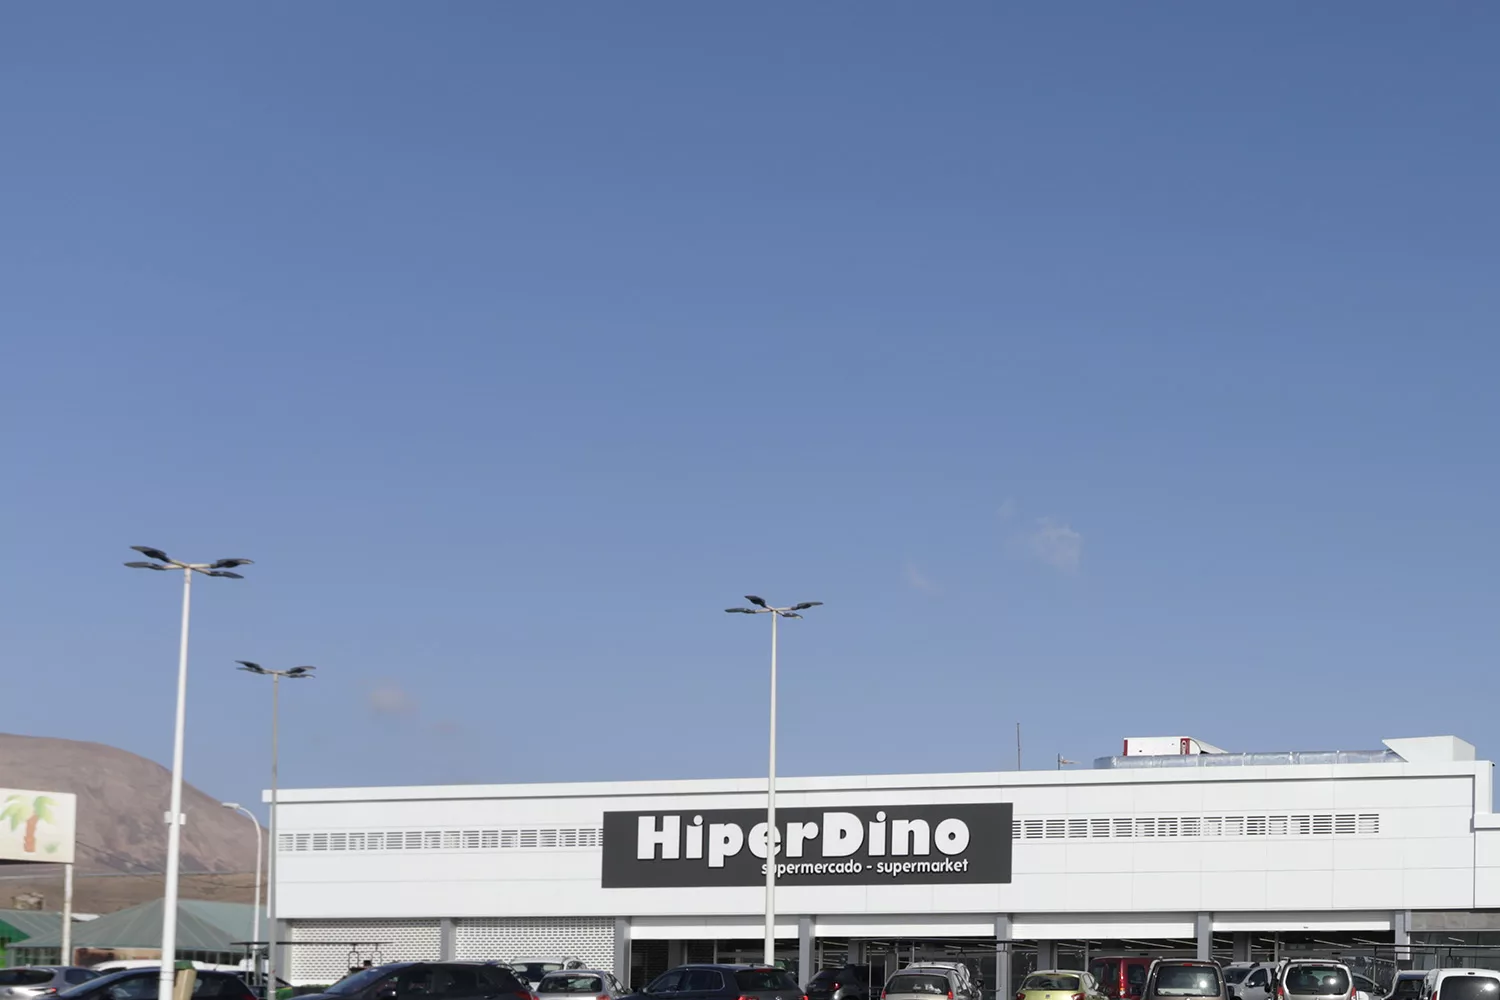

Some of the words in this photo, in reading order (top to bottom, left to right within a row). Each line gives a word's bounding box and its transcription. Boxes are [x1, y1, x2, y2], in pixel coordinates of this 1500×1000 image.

[637, 811, 970, 867] HiperDino
[761, 859, 862, 877] spermercado
[876, 858, 969, 876] supermarket
